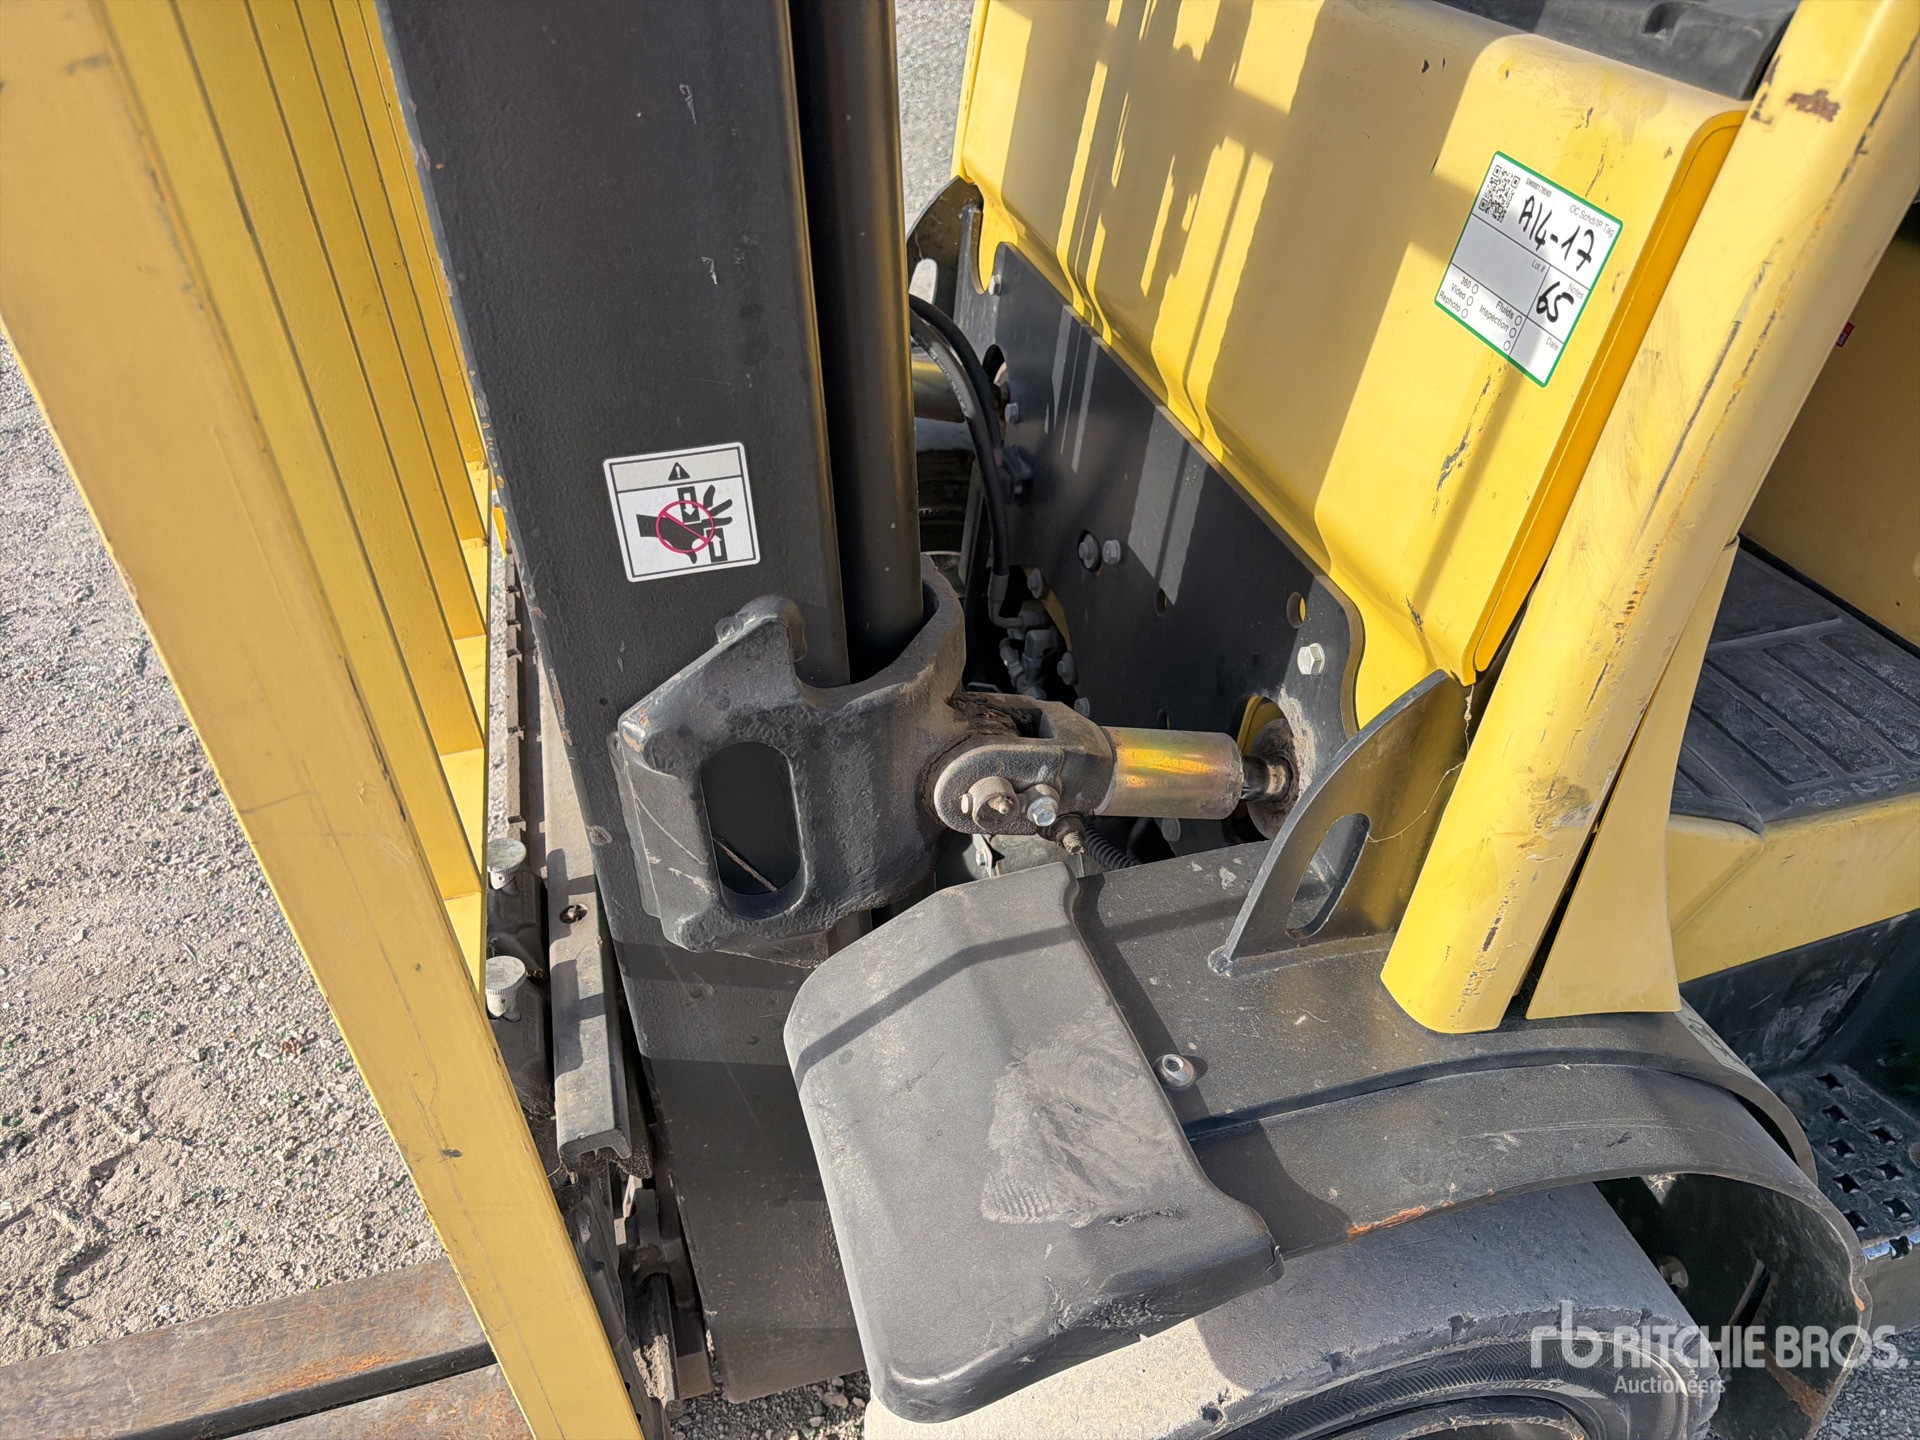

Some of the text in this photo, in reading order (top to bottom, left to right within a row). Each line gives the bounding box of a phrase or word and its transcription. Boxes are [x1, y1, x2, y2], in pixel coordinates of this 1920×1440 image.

[1569, 204, 1579, 215] OC
[1603, 223, 1615, 238] Tag
[1518, 195, 1595, 271] A14-17
[1531, 259, 1541, 271] Lot
[1451, 283, 1466, 300] Video
[1460, 276, 1471, 289] 360
[1567, 283, 1584, 300] Notes
[1438, 291, 1461, 313] Rephoto
[1495, 300, 1515, 320] Fluids
[1536, 281, 1574, 323] 65
[1479, 305, 1509, 332] Inspection
[1546, 337, 1559, 351] Date
